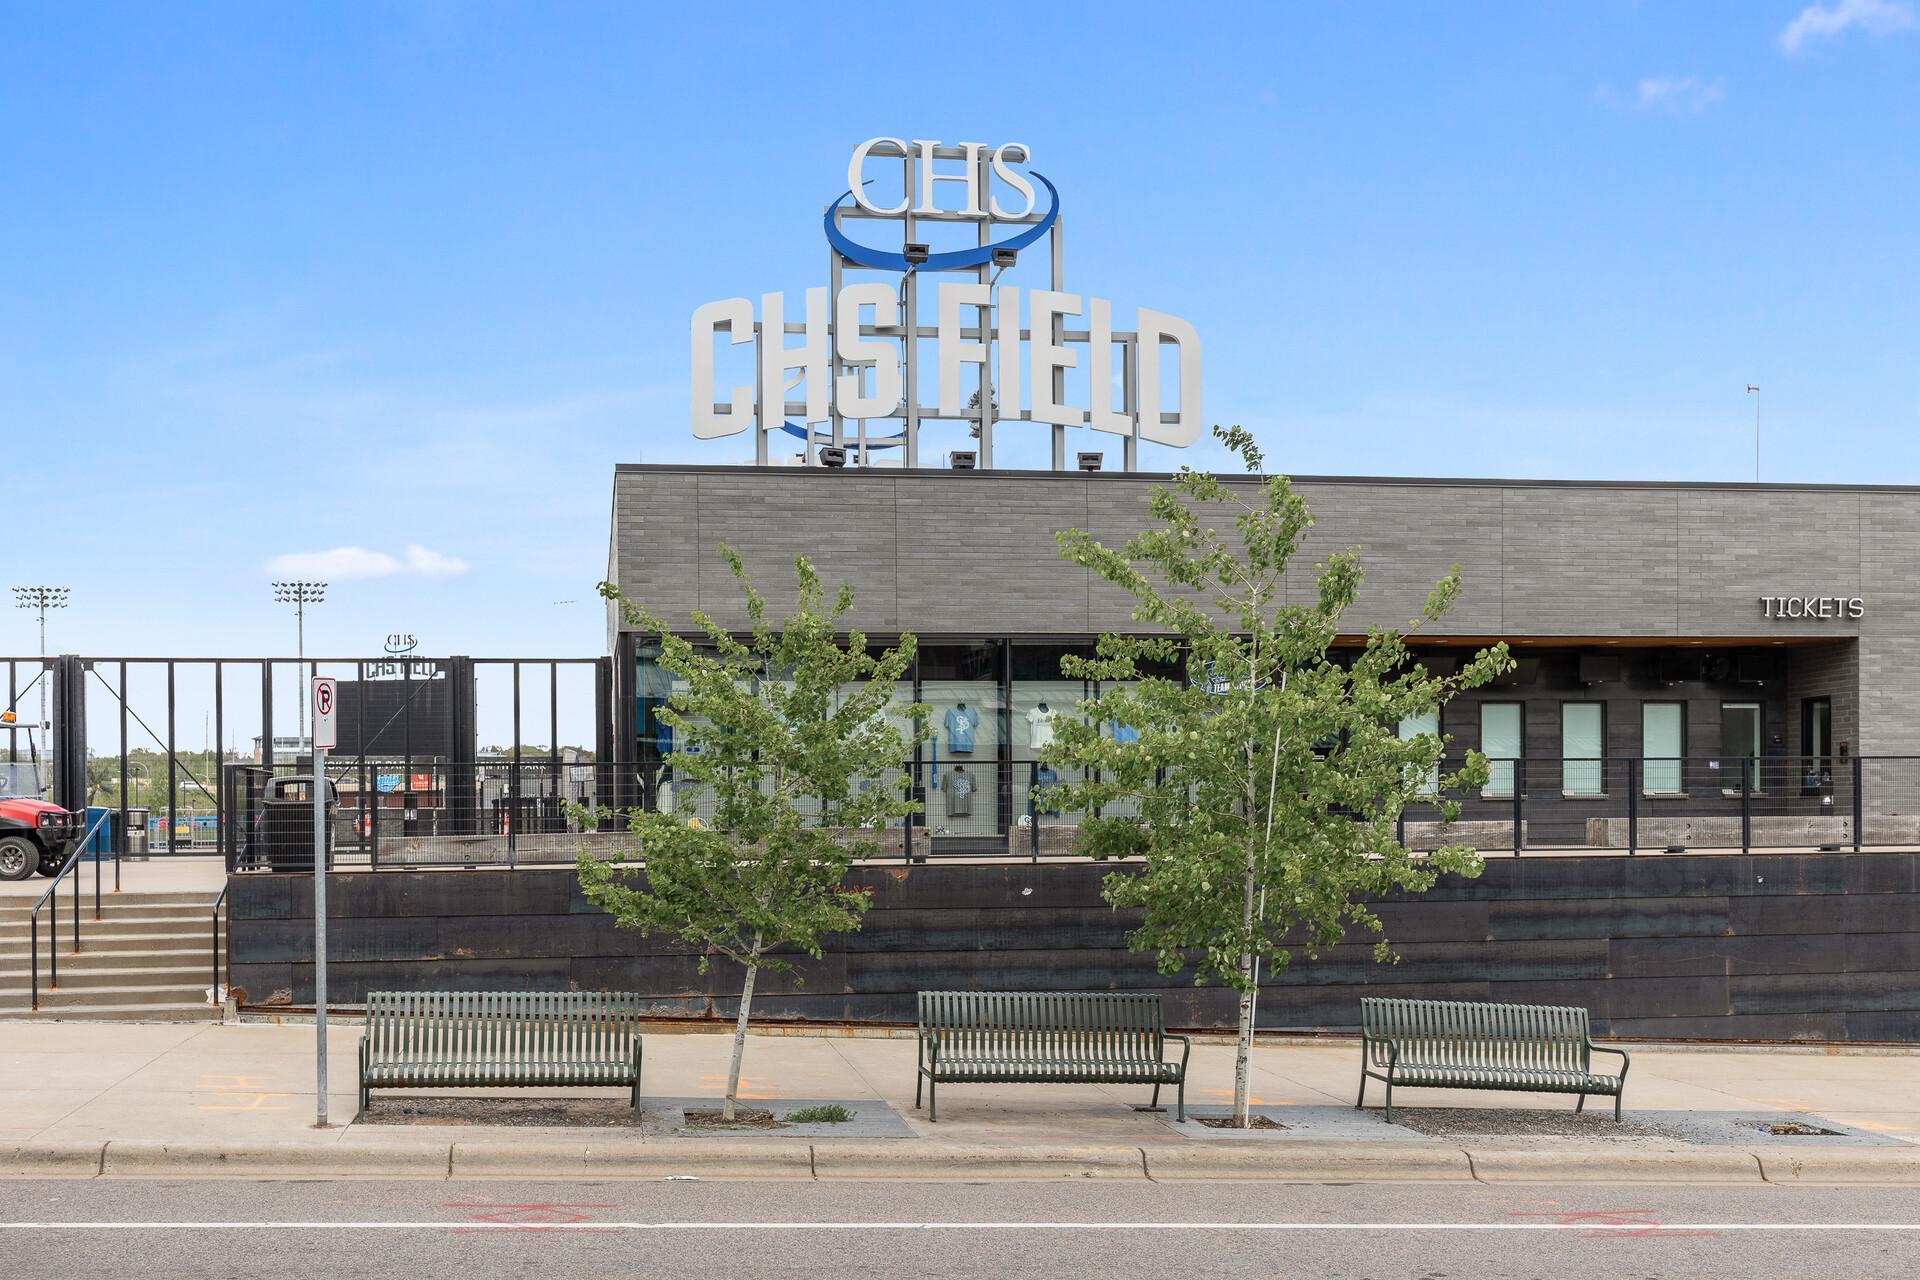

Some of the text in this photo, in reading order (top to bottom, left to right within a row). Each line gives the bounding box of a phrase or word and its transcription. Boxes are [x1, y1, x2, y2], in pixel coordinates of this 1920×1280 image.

[847, 136, 1036, 219] CHS
[690, 282, 1202, 449] CHS FIELD
[1760, 596, 1865, 618] TICKETS
